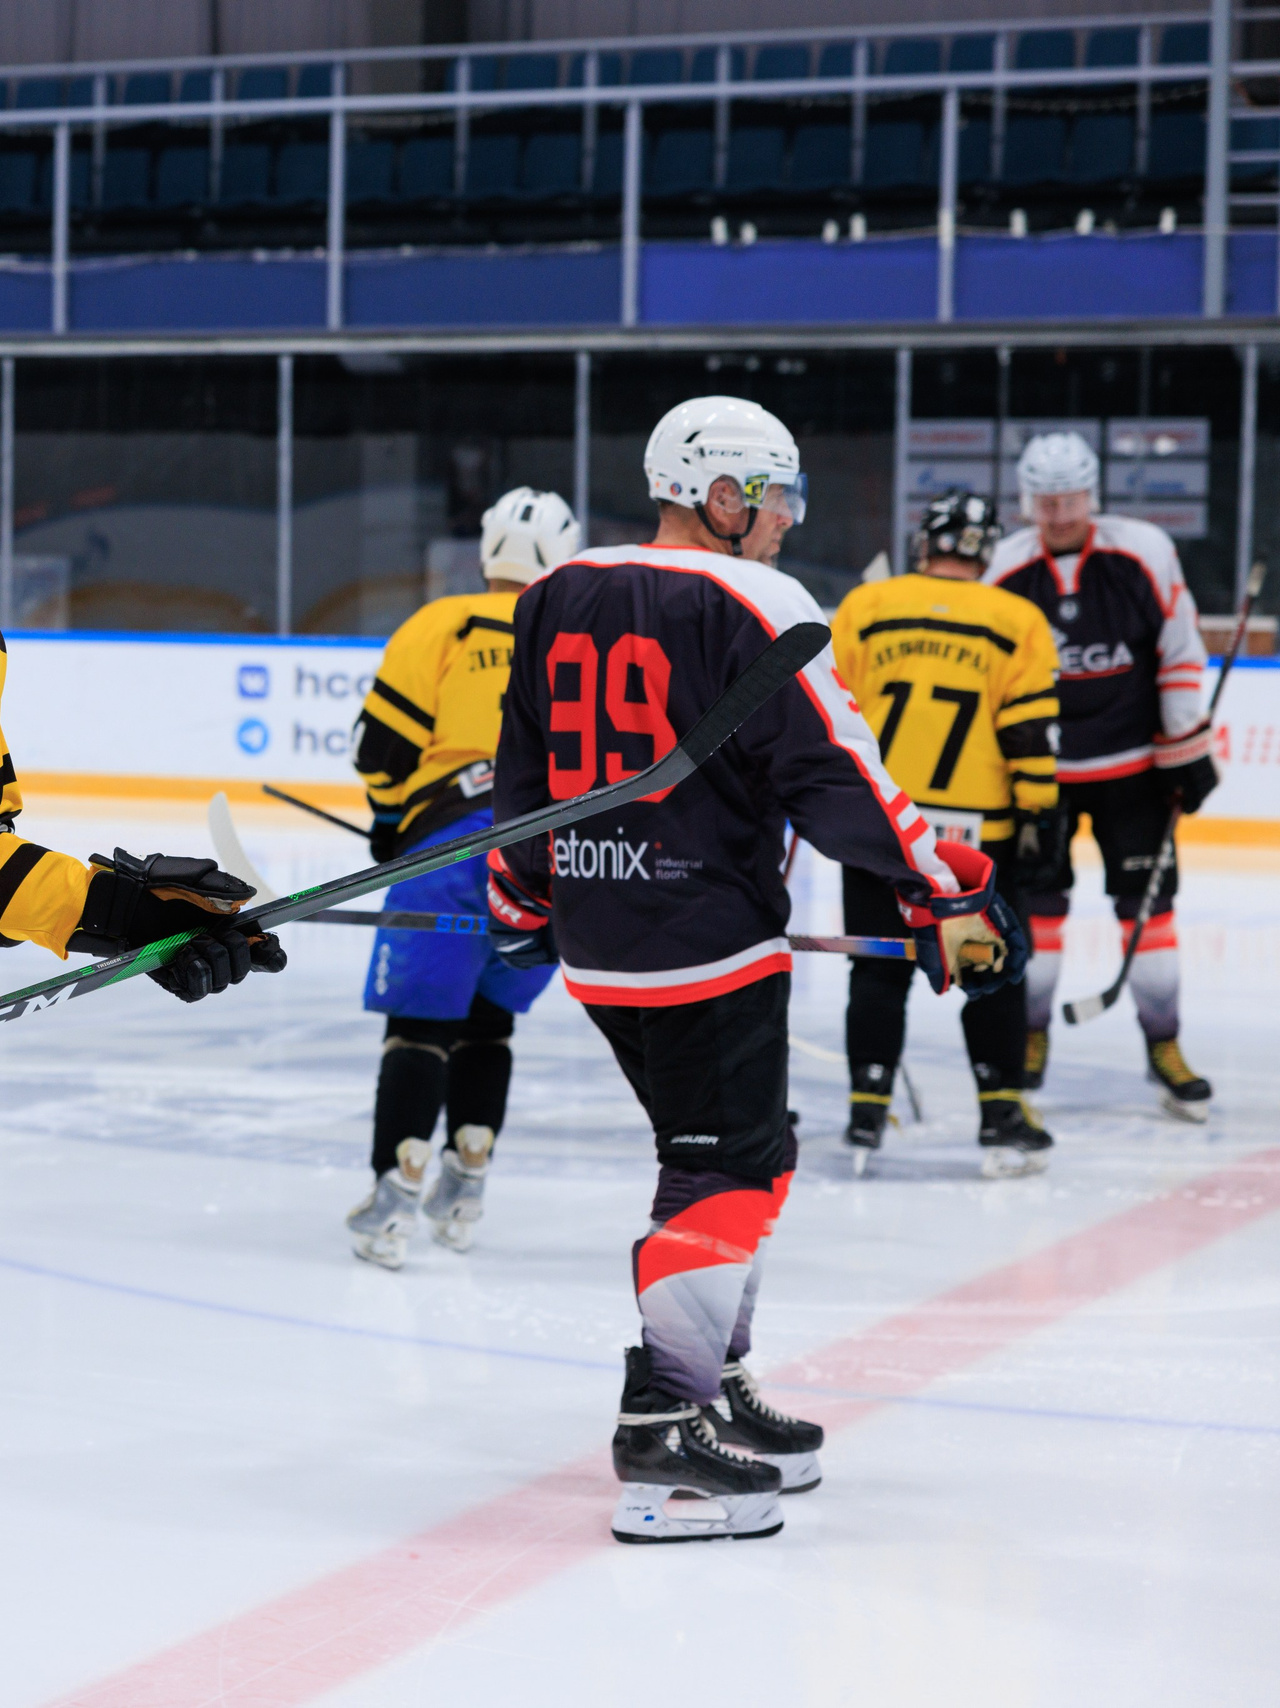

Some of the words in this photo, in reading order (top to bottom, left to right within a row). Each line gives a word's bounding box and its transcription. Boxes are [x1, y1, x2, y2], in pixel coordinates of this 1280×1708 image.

[293, 721, 355, 756] hc
[546, 631, 678, 803] 99
[875, 682, 981, 791] 17
[548, 826, 651, 880] etonix
